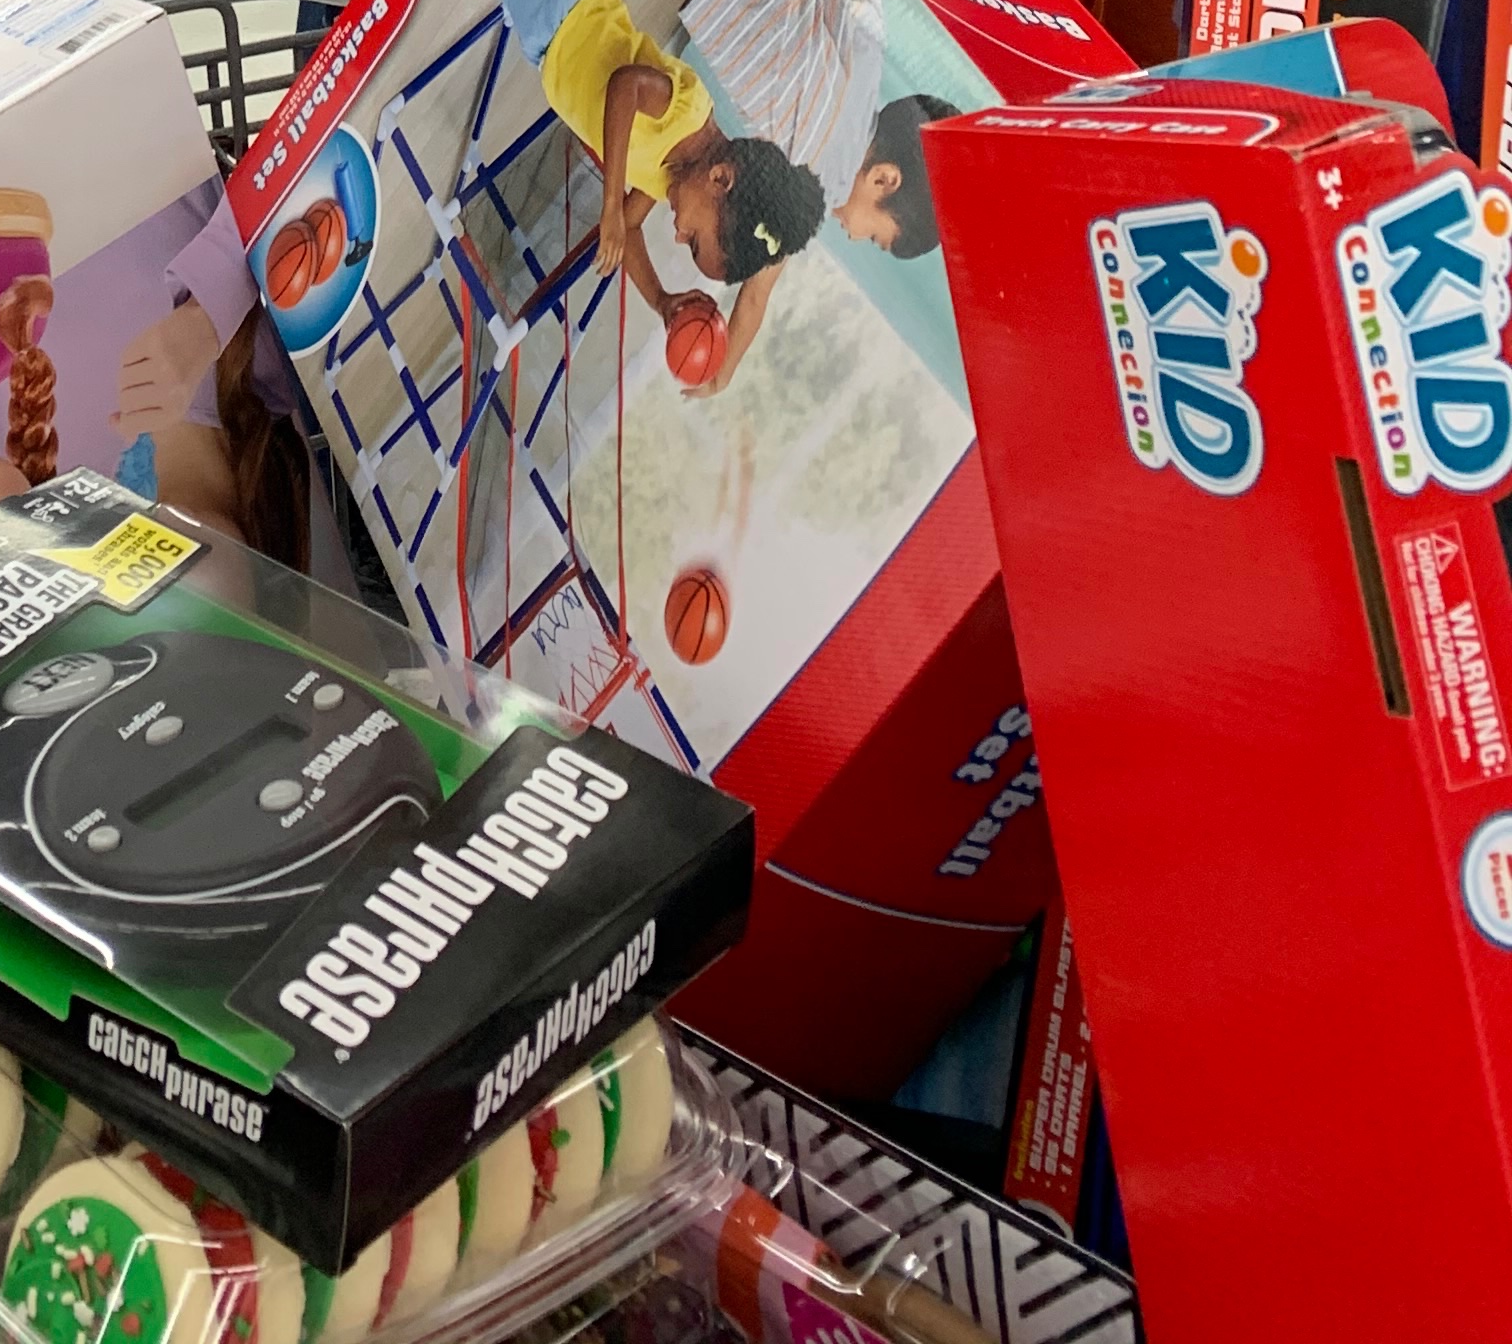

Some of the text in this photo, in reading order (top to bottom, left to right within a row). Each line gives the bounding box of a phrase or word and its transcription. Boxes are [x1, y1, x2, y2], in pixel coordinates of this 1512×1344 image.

[976, 115, 1227, 134] Truck Carry Case
[253, 140, 288, 191] Set
[1317, 167, 1344, 211] 3+
[1124, 214, 1254, 482] KID
[1376, 183, 1512, 478] KID
[116, 538, 184, 590] 5,000
[120, 529, 157, 559] words
[37, 573, 87, 607] THE
[23, 654, 97, 691] NEXT
[284, 670, 320, 704] team 1
[1447, 599, 1507, 777] WARNING:
[118, 700, 166, 741] category
[956, 706, 1032, 782] Set
[280, 805, 306, 829] stop
[310, 787, 326, 803] go
[64, 808, 107, 843] team 2
[1489, 852, 1510, 920] Pieces
[1030, 915, 1074, 1172] SUPER DRUM BLAST
[1050, 1052, 1072, 1137] DARTS
[1063, 1061, 1087, 1158] BARREL
